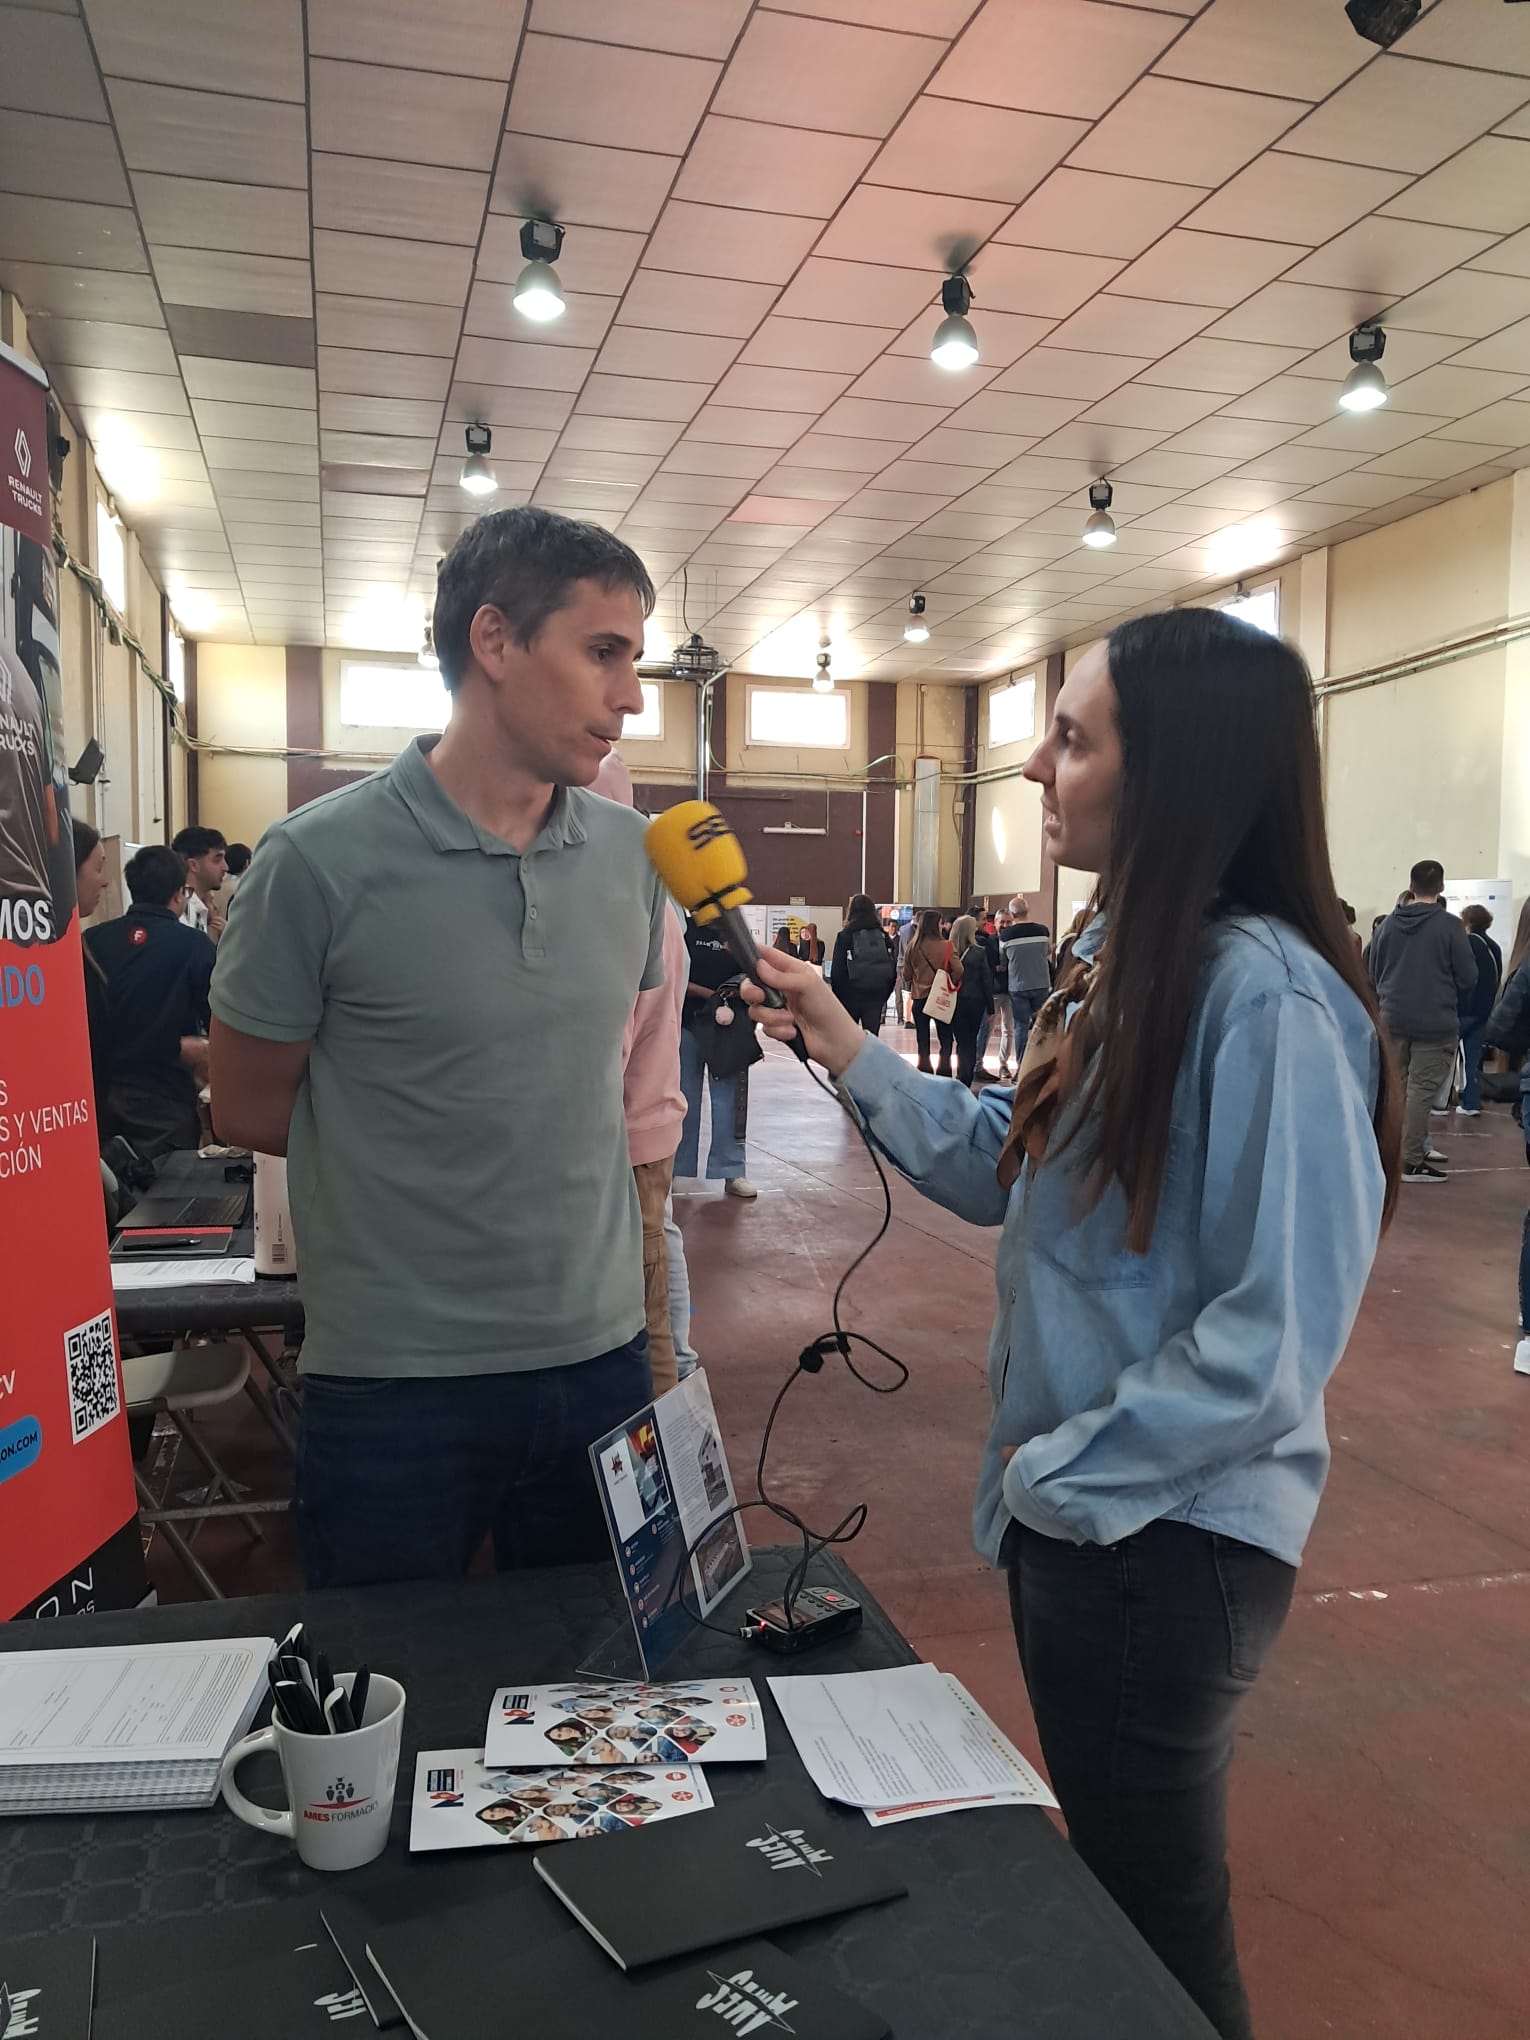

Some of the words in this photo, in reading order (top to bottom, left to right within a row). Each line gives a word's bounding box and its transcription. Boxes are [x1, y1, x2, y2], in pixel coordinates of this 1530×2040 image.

[8, 474, 43, 503] RENAULT
[12, 489, 42, 516] TRUCKS
[0, 1116, 10, 1142] S
[13, 1111, 25, 1138] Y
[29, 1099, 88, 1134] VENTAS
[0, 1141, 42, 1178] CIÓN
[303, 1809, 330, 1823] AMES
